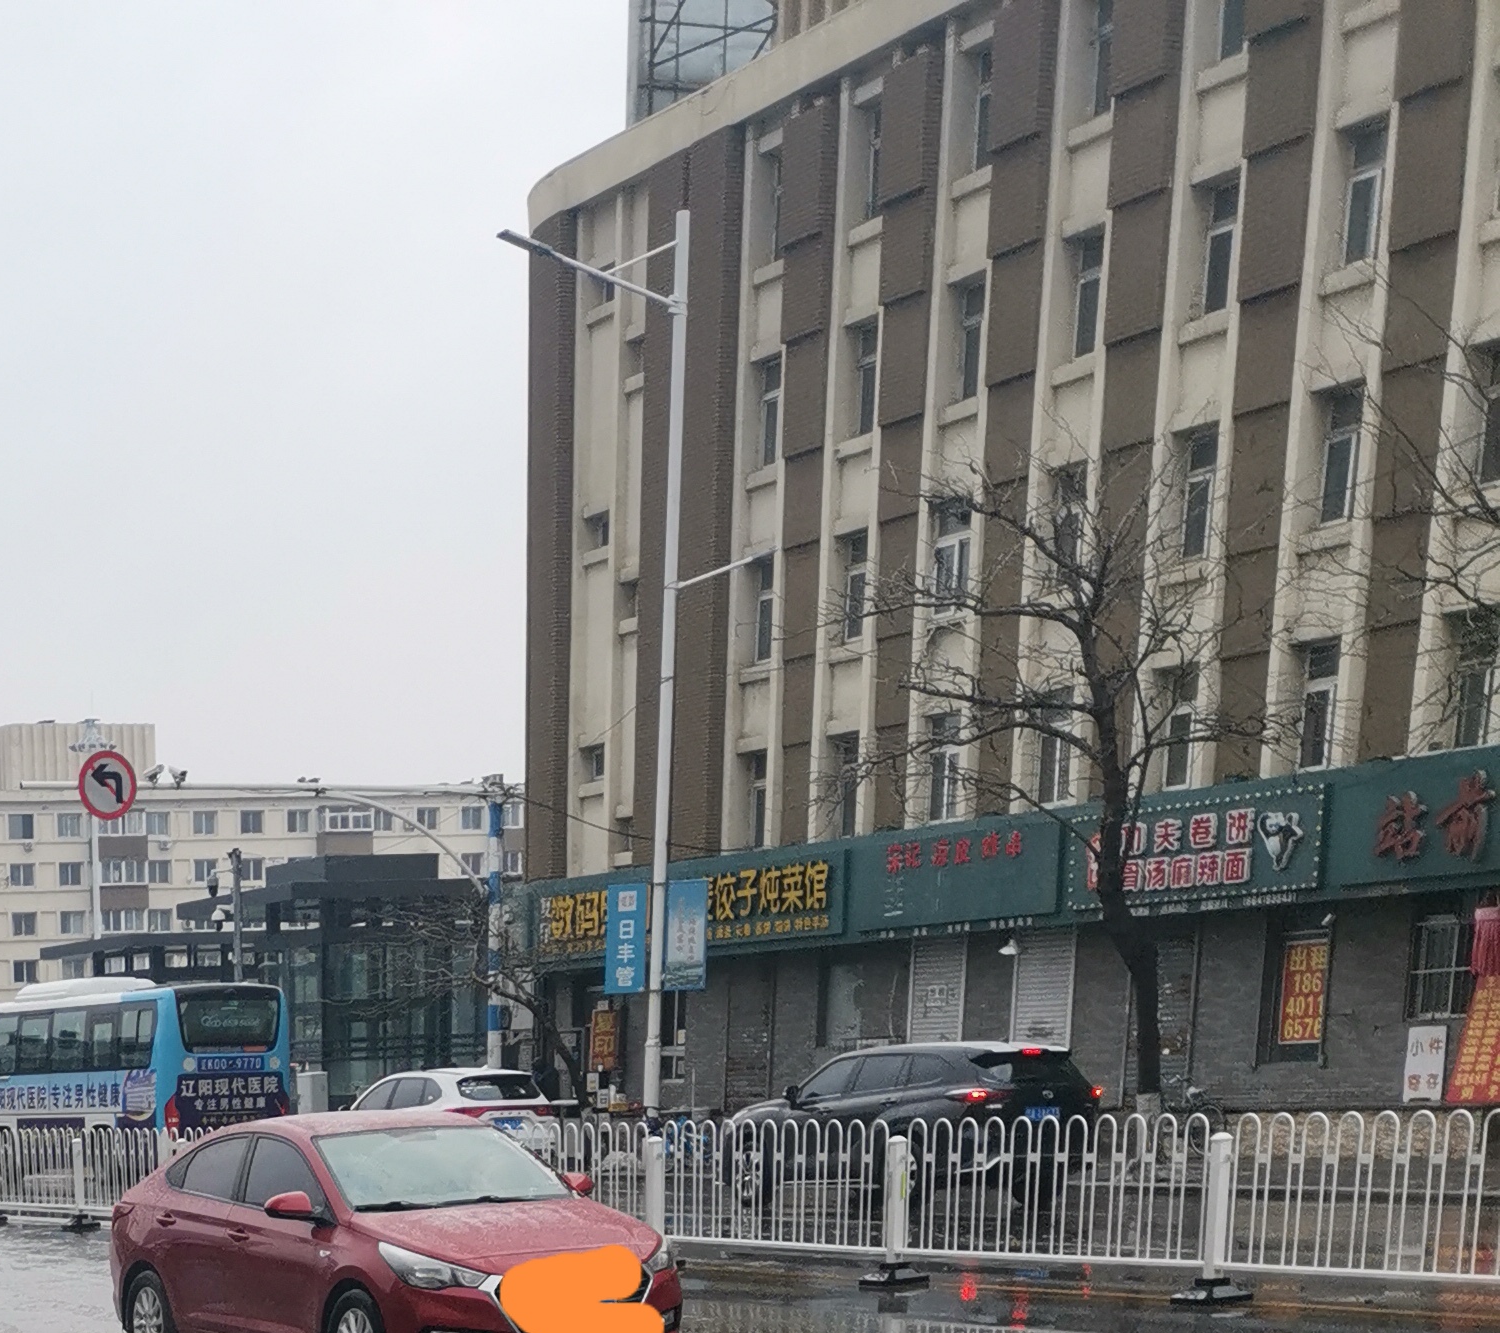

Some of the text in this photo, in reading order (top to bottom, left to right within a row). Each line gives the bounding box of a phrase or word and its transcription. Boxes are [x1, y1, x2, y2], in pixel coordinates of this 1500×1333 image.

[616, 919, 636, 987] 日丰管
[1289, 945, 1327, 971] 出租
[1293, 973, 1322, 993] 186
[1410, 1037, 1443, 1057] 小件
[50, 1082, 121, 1109] 专注男性健康
[180, 1076, 279, 1097] 辽阳现代医院
[194, 1096, 266, 1111] 专注男性健康
